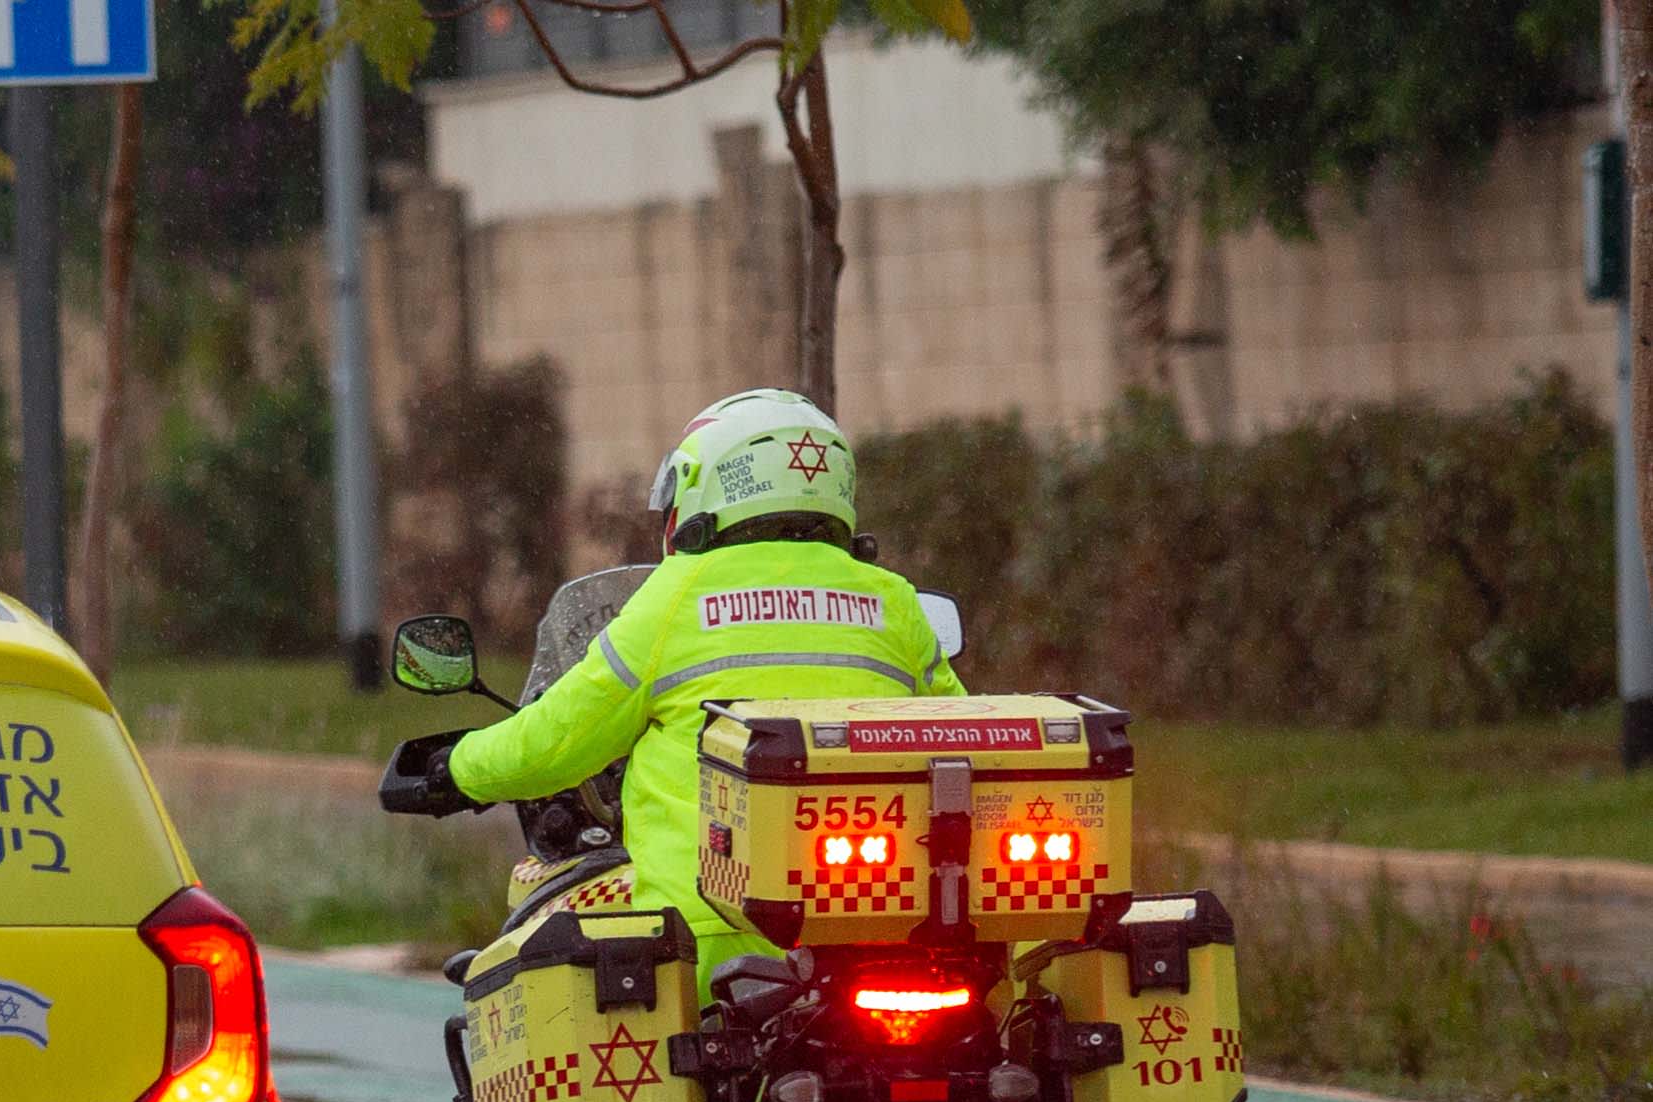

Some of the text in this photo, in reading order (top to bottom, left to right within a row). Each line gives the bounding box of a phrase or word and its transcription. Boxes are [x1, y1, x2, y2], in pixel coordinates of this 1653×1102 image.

[717, 453, 754, 475] MAGEN
[721, 466, 751, 485] DAVID
[725, 475, 754, 495] ADOM
[726, 480, 774, 504] IN ISRAEL
[706, 590, 878, 626] יחידת האופנועים
[853, 725, 1032, 745] ארגון ההצלה הלאומי
[794, 795, 907, 831] 5554
[1132, 1057, 1203, 1086] 101
